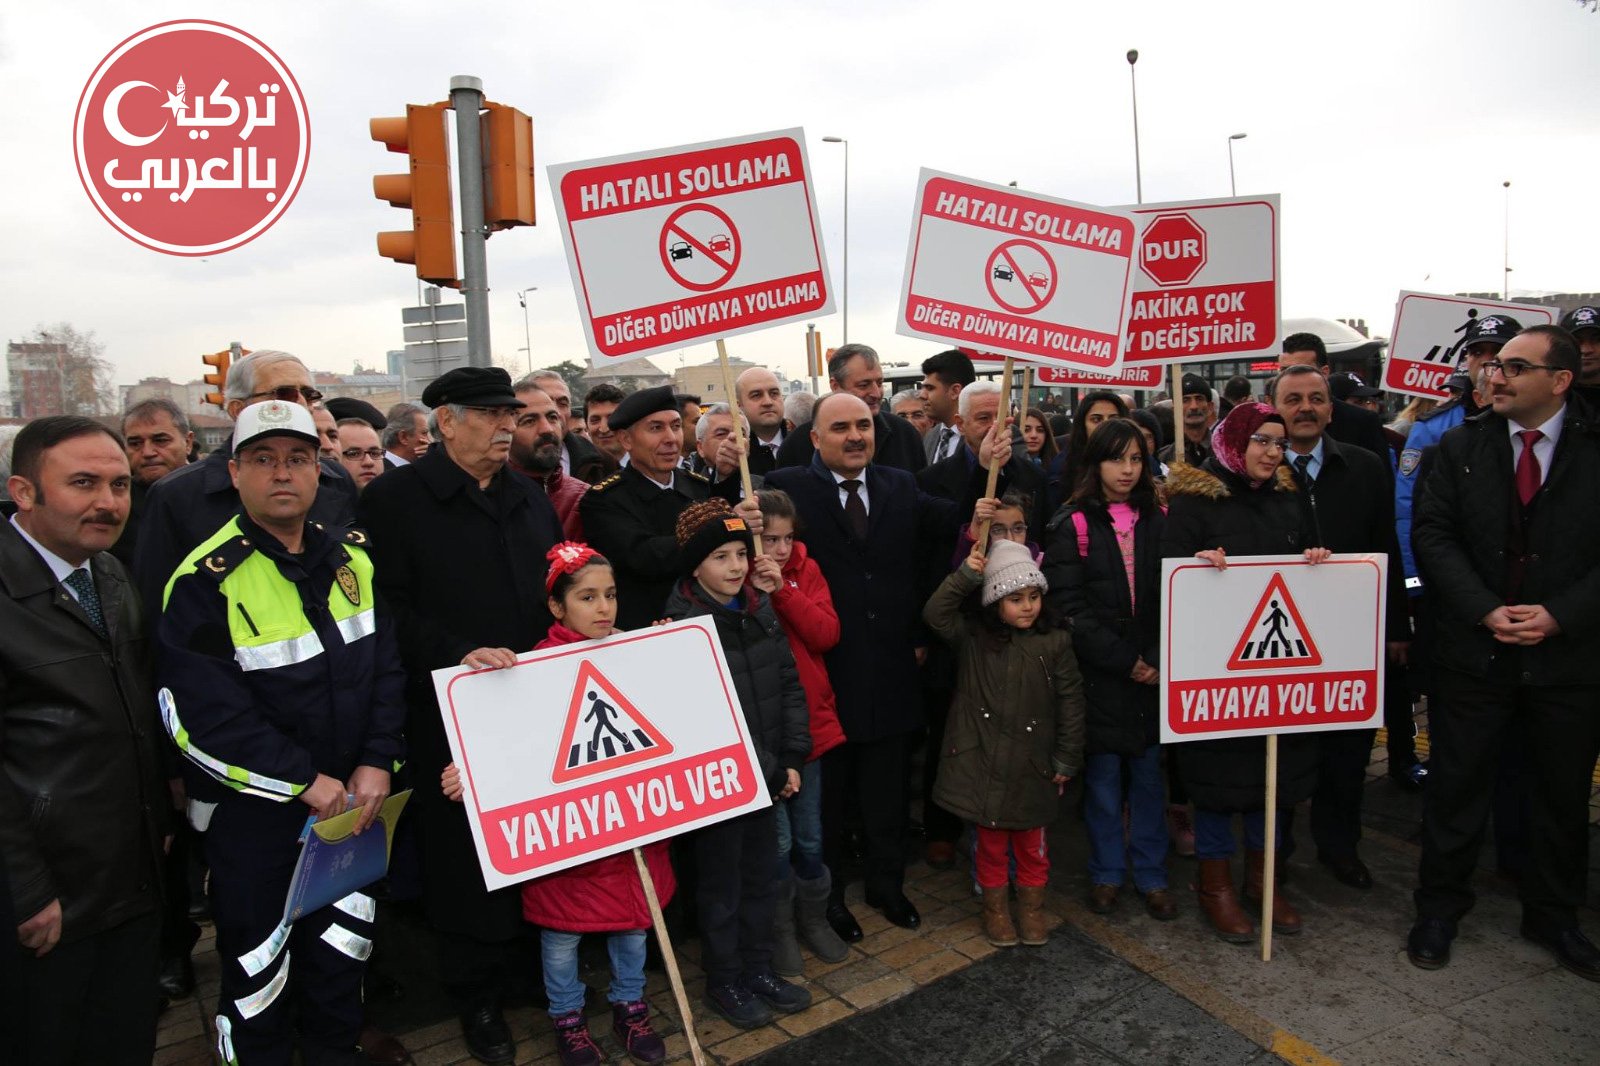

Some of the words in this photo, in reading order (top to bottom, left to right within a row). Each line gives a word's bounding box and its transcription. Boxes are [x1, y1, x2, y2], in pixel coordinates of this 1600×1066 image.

[580, 172, 672, 212] HATALI
[679, 153, 791, 195] SOLLAMA
[935, 191, 1019, 228] HATALI
[1020, 213, 1123, 250] SOLLAMA
[1145, 238, 1200, 262] DUR
[604, 315, 657, 346] DİĞER
[660, 297, 742, 334] DÜNYAYA
[745, 280, 820, 315] YOLLAMA
[913, 302, 959, 329] DİĞER
[962, 313, 1038, 345] DÜNYAYA
[1042, 332, 1112, 359] YOLLAMA
[1204, 291, 1246, 319] ÇOK
[1141, 317, 1256, 351] DEĞİŞTİRİR
[1180, 684, 1270, 723] YAYAYA
[1276, 682, 1316, 715] YOL
[1323, 680, 1366, 713] VER
[499, 790, 625, 860] YAYAYA
[626, 775, 684, 822] YOL
[684, 757, 743, 806] VER
